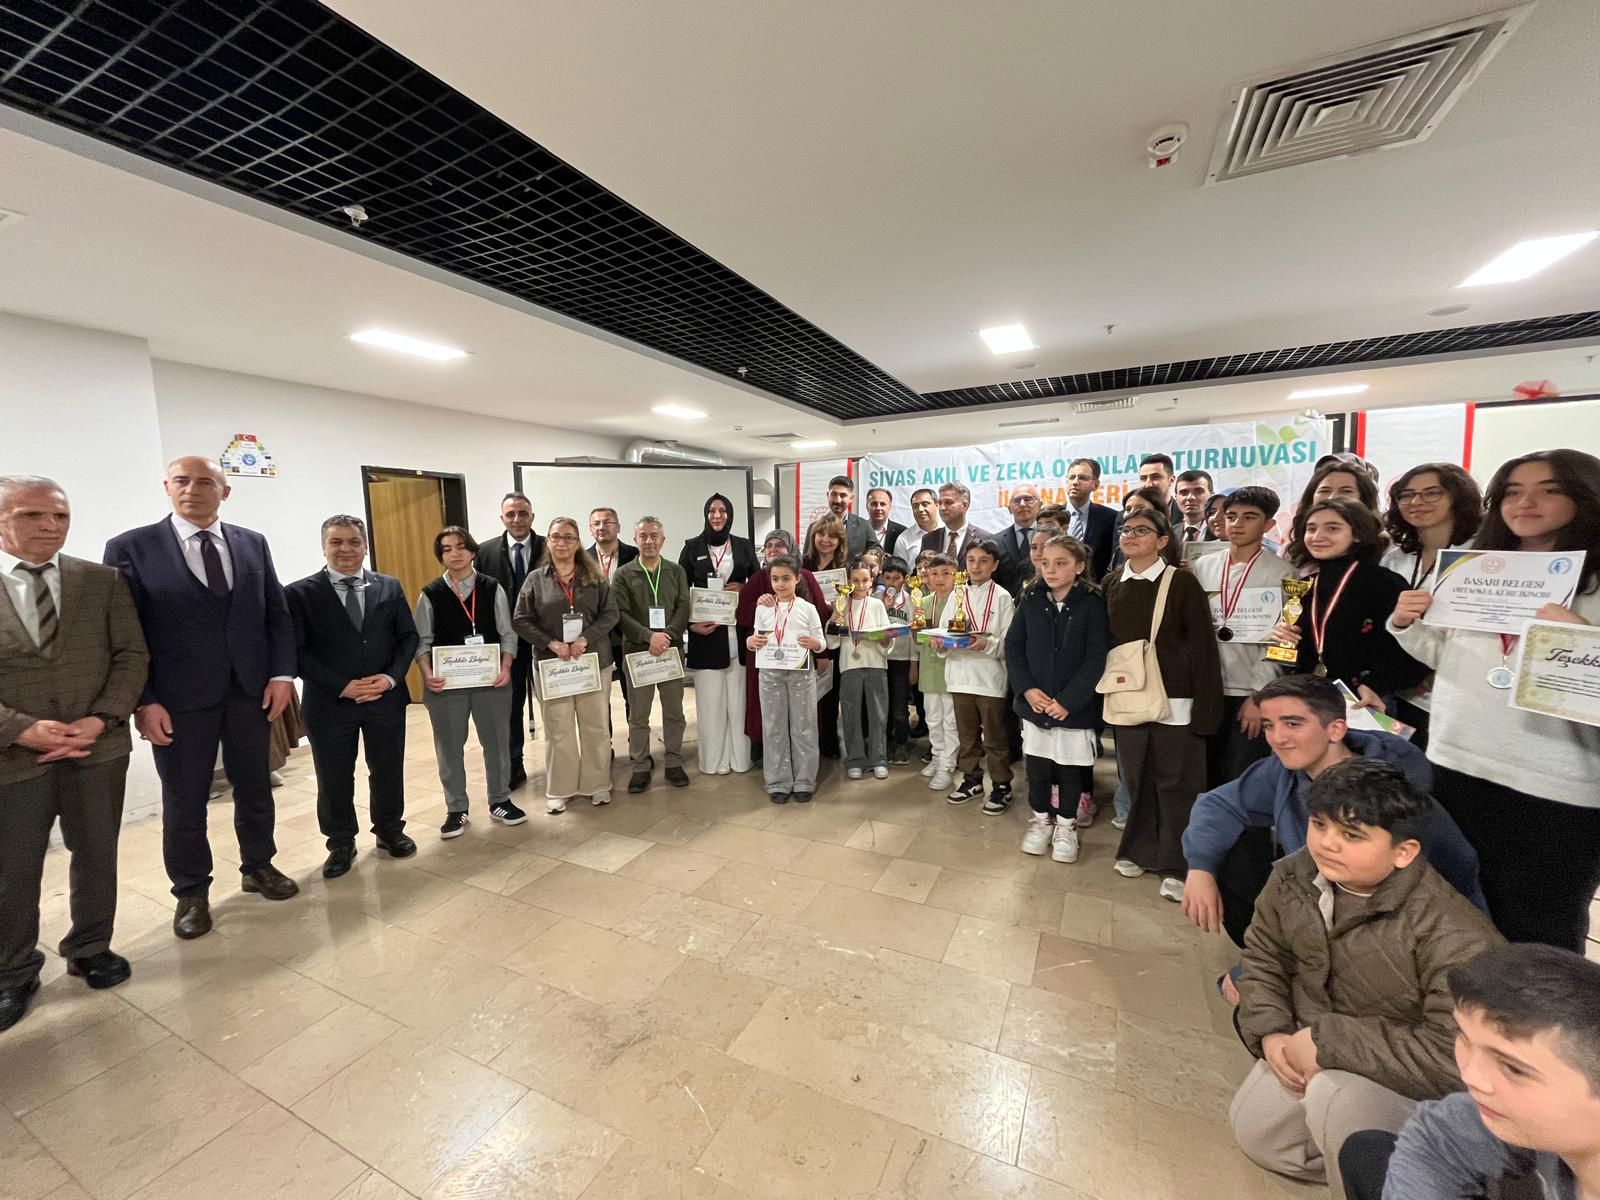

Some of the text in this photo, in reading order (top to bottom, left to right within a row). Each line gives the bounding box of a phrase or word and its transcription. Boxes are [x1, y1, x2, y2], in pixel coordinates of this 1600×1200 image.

[869, 467, 916, 488] SİVAS
[922, 466, 961, 485] AKIL
[967, 464, 991, 482] VE
[996, 460, 1044, 481] ZEKA
[1172, 441, 1317, 471] TURNUVASI
